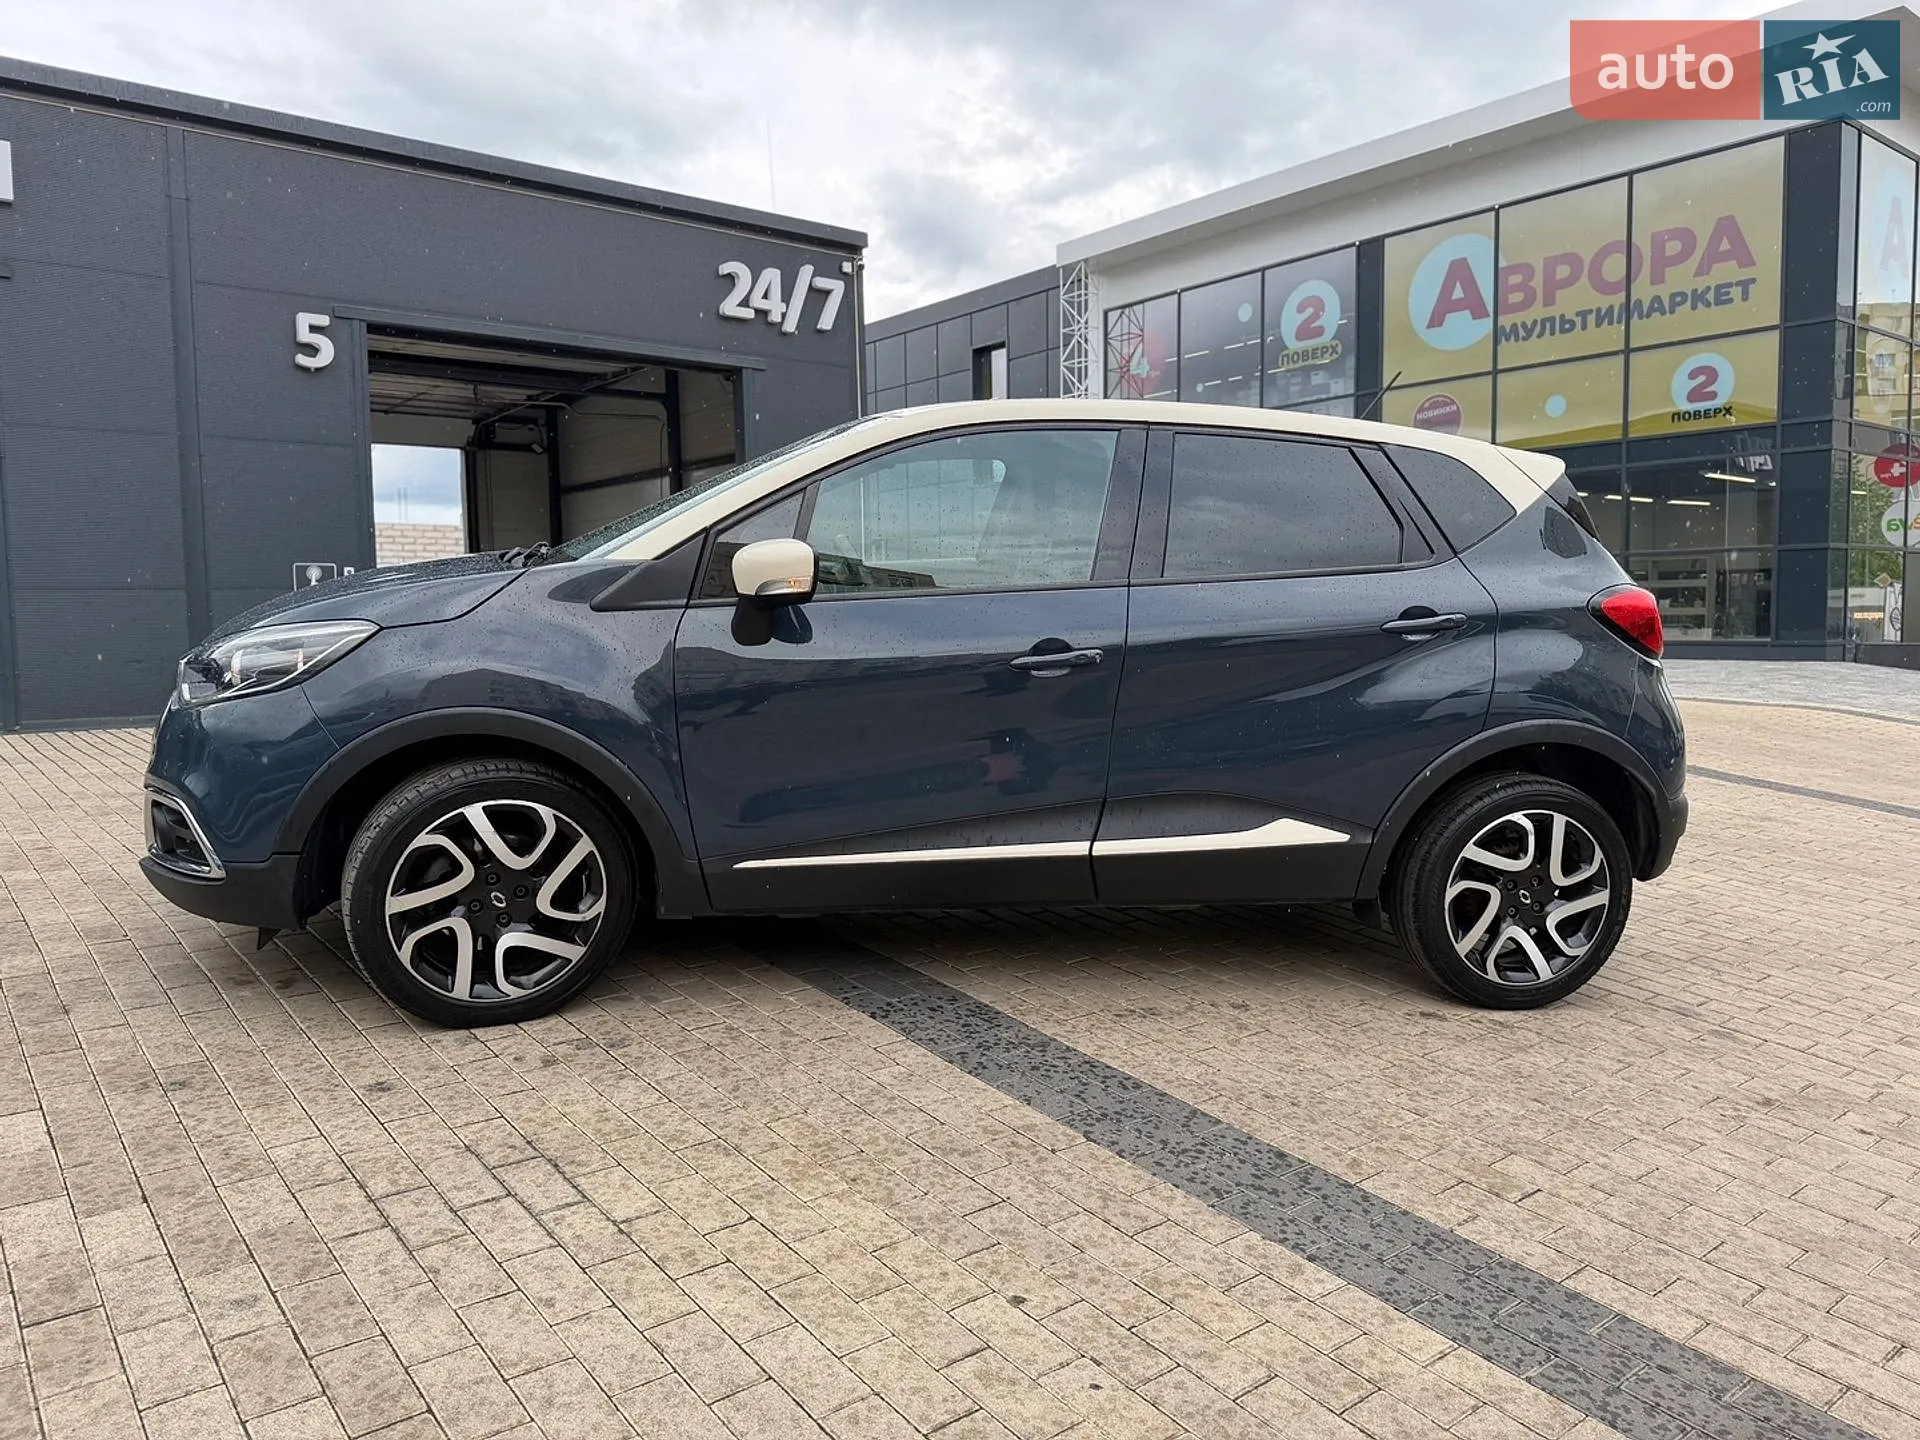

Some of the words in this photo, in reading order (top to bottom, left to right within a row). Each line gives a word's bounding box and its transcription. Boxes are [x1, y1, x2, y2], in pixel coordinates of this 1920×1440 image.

[718, 261, 845, 333] 24/7
[1425, 214, 1757, 330] АВРОРА
[1294, 295, 1326, 342] 2
[1497, 277, 1757, 344] МУЛЬТИМАРКЕТ
[294, 312, 335, 369] 5
[1280, 343, 1339, 366] ПОВЕРХ
[1686, 365, 1719, 404] 2
[1671, 406, 1734, 423] ПОВЕРХ
